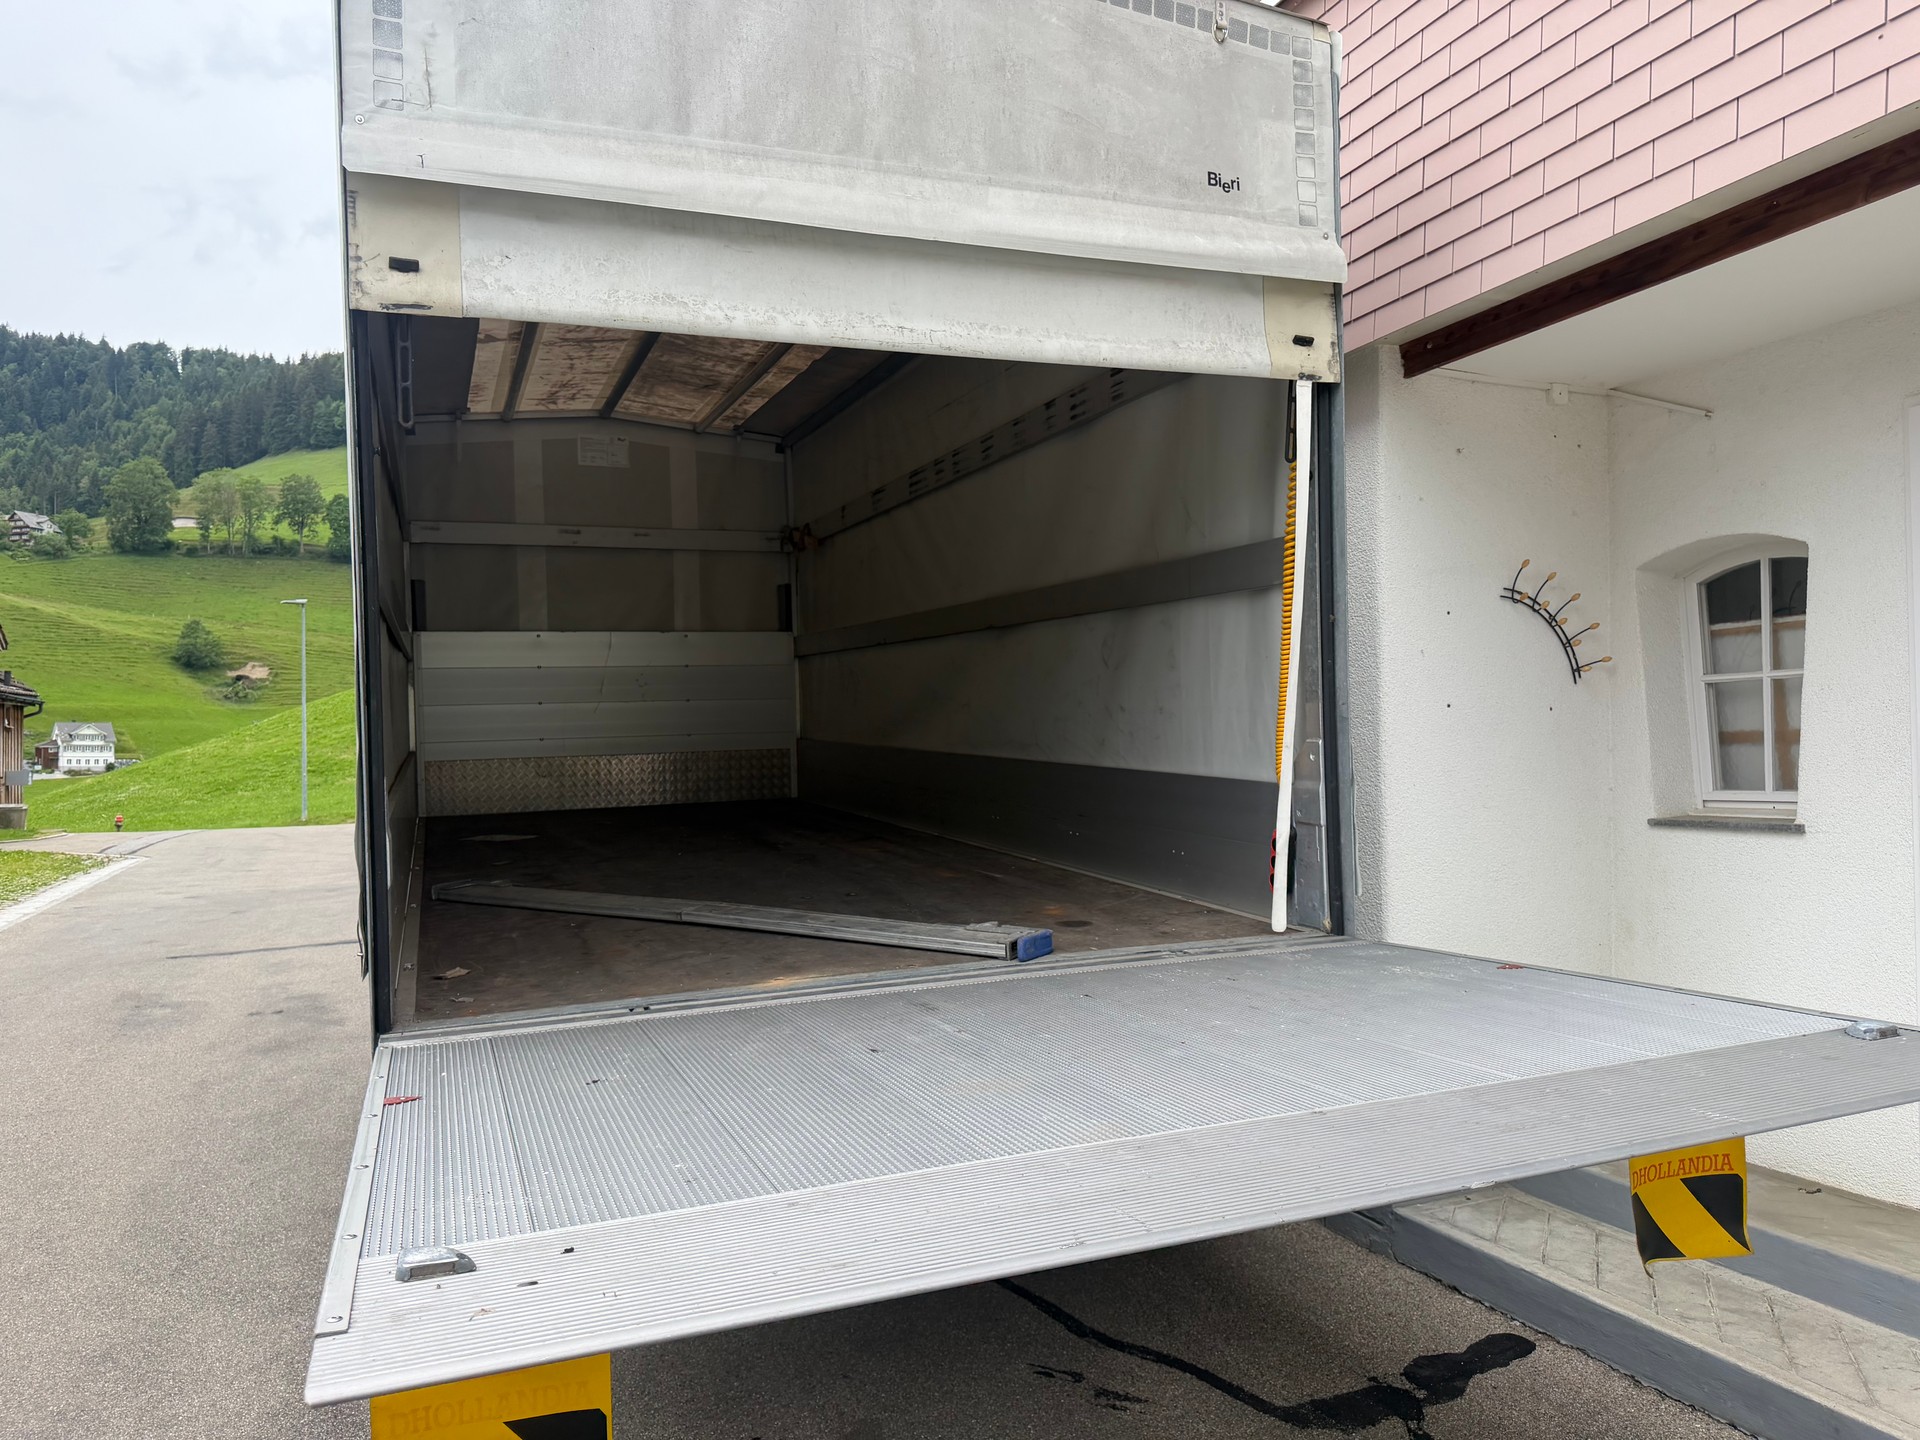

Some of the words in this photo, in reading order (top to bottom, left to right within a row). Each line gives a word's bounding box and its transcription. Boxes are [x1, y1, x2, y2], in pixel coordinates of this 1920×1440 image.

[1207, 171, 1240, 193] Bieri
[1632, 1153, 1734, 1191] DHOLLANDIA
[389, 1380, 592, 1437] DHOLLANDIA
